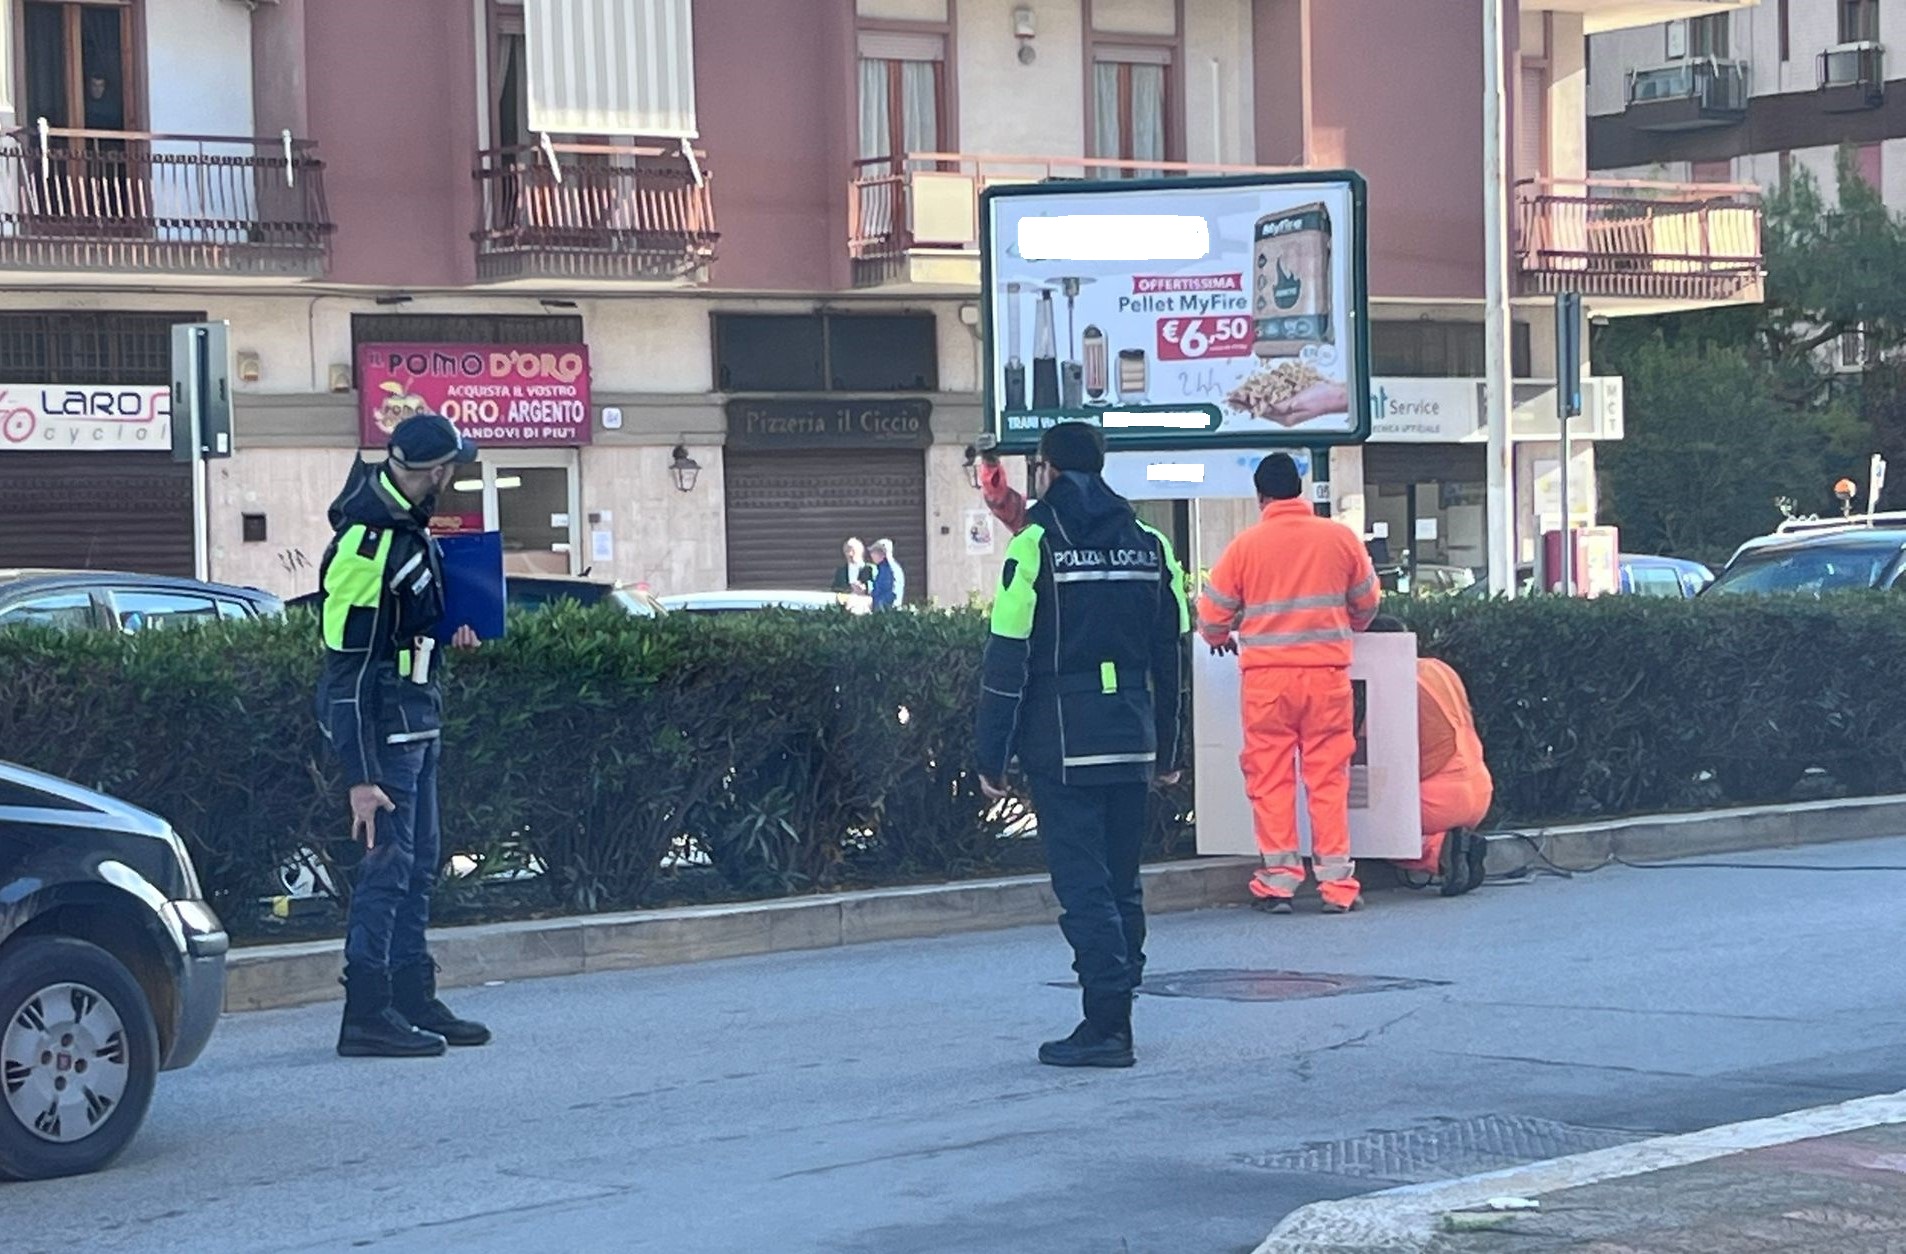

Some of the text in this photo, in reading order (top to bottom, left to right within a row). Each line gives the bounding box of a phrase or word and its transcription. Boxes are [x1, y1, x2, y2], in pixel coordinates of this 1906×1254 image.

[1138, 277, 1236, 291] OFFERTISSIMA
[1118, 294, 1248, 314] Pellet MyFire
[1162, 317, 1249, 357] €6,50
[489, 350, 583, 382] D'ORO
[447, 385, 577, 398] ACQUISTA IL VOSTRO
[507, 399, 585, 423] ARGENTO
[1389, 399, 1440, 416] Service
[746, 409, 920, 434] Pizzeria il Ciccio
[461, 427, 520, 438] ANDOVI
[523, 427, 538, 438] DI
